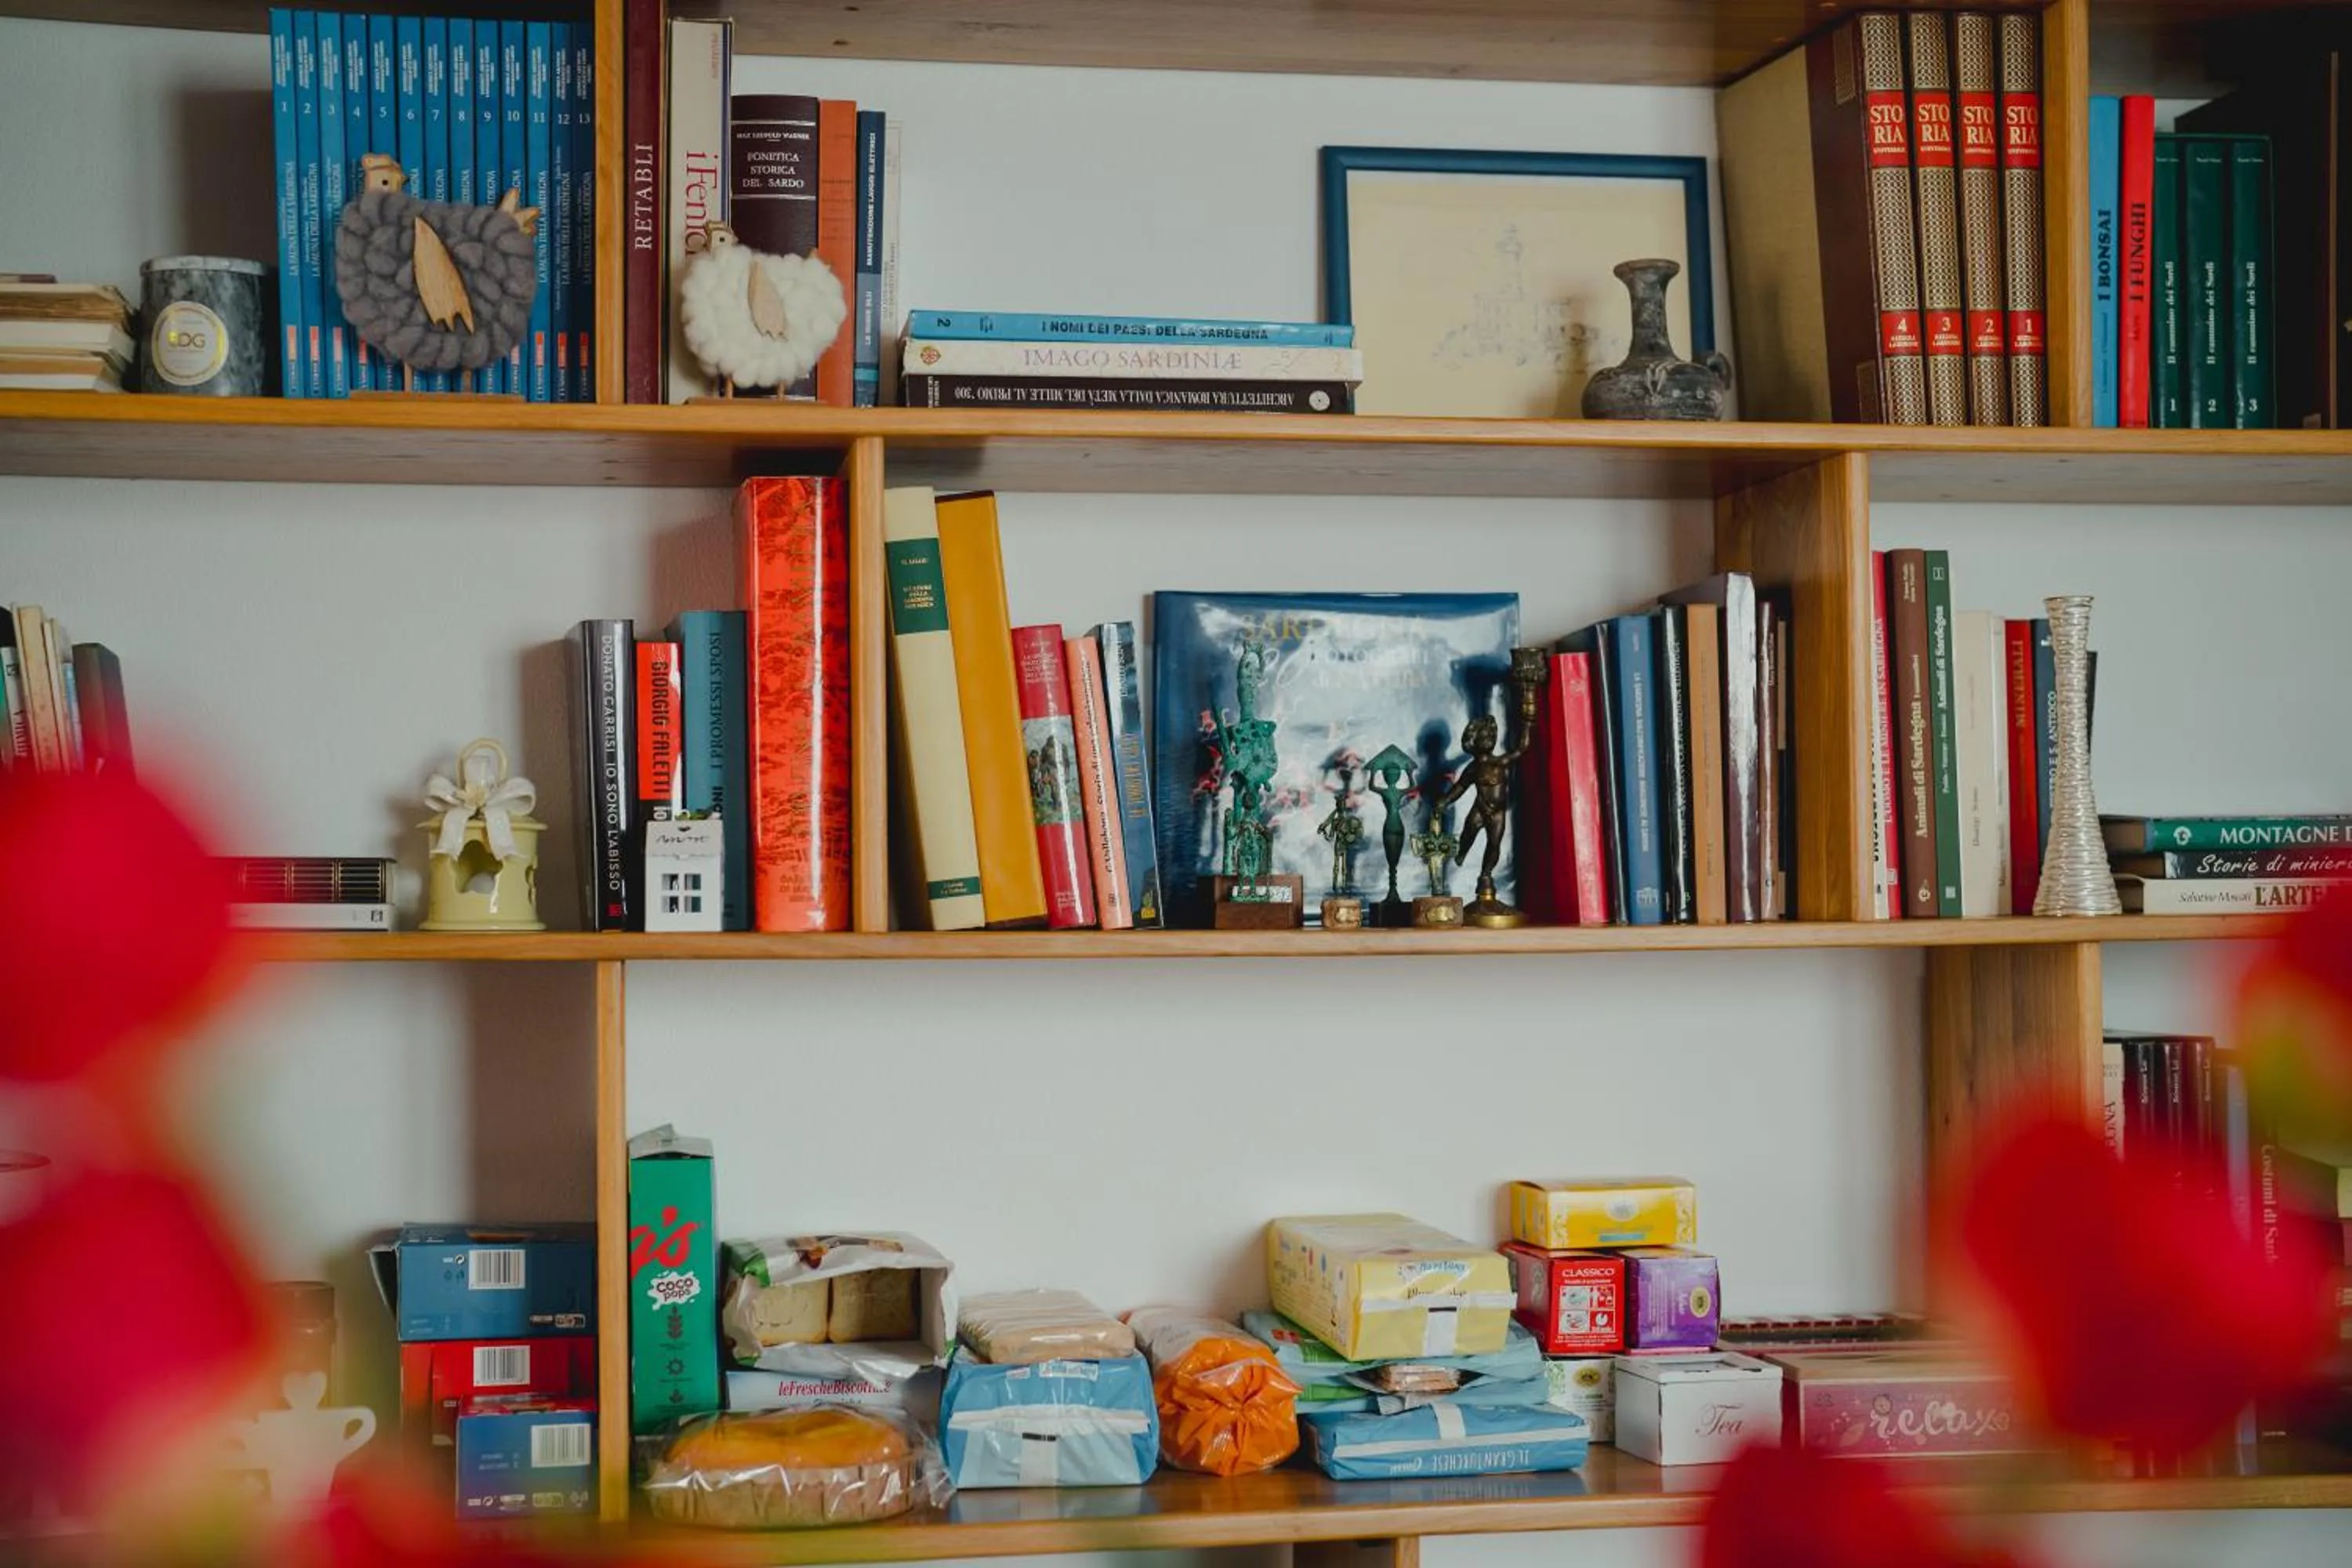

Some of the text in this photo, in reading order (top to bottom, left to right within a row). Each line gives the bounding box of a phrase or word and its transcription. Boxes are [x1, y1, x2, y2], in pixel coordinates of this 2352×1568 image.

[281, 102, 287, 111] 1
[304, 103, 311, 114] 2
[328, 104, 335, 114] 3
[353, 107, 361, 118] 4
[379, 107, 387, 118] 5
[1870, 105, 1903, 123] STO
[1918, 103, 1950, 122] STO
[407, 109, 415, 120] 6
[432, 110, 440, 121] 7
[458, 111, 465, 121] 8
[484, 111, 492, 122] 9
[507, 111, 520, 122] 10
[534, 112, 545, 122] 11
[557, 114, 569, 125] 12
[579, 114, 590, 124] 13
[1964, 106, 1994, 124] STO
[2006, 106, 2038, 125] STO
[1874, 125, 1904, 143] RIA
[1922, 124, 1950, 142] RIA
[1966, 125, 1994, 144] RIA
[2009, 126, 2038, 144] RIA
[747, 152, 800, 162] FONETICA
[750, 165, 796, 175] STORICA
[742, 178, 804, 188] DEL SARDO
[634, 143, 653, 249] RETABLI
[285, 162, 299, 275] LA FAUNA DELLA SARDEGNA
[308, 162, 320, 277] LA FAUNA DELLA SARDEGNA
[561, 219, 570, 245] DELLA
[2097, 209, 2111, 287] BONSAI
[2130, 202, 2145, 286] FUNGHI
[561, 246, 570, 272] FAUNA
[539, 273, 547, 282] LA
[561, 274, 571, 285] LA
[2165, 262, 2174, 288] Sardi
[2205, 262, 2214, 288] Sardi
[2246, 262, 2255, 288] Sardi
[2165, 290, 2174, 305] dei
[2205, 290, 2214, 305] dei
[2246, 290, 2256, 305] dei
[936, 318, 951, 327] 2
[1042, 321, 1268, 339] I NOMI DEI PAESI DELLA SARDEGNA
[1897, 318, 1907, 332] 4
[1942, 317, 1951, 331] 3
[1985, 318, 1994, 332] 2
[2026, 318, 2032, 332] 1
[1023, 350, 1243, 368] IMAGO SARDINIÆ
[978, 388, 1011, 401] PRIMO
[1013, 388, 1027, 401] AL
[1029, 388, 1063, 401] MILLE
[1065, 389, 1085, 401] DEL
[1120, 390, 1153, 403] DALLA
[1156, 390, 1210, 405] ROMANICA
[1213, 391, 1294, 405] ARCHITETTURA
[2170, 398, 2176, 412] 1
[2208, 398, 2216, 412] 2
[2249, 398, 2257, 412] 3
[709, 633, 722, 676] SPOSI
[1934, 605, 1947, 710] Animali di Sardegna
[2012, 641, 2026, 728] MINERALI
[652, 662, 670, 725] GIORGIO
[710, 681, 723, 758] PROMESSI
[2048, 691, 2056, 742] ANTIOCO
[1910, 702, 1927, 768] Sardegna
[602, 635, 620, 891] DONATO CARRISI IO SONO L'ABISSO
[652, 731, 670, 793] FALETTI
[1913, 771, 1925, 784] di
[1915, 786, 1928, 837] Animali
[2220, 826, 2339, 844] MONTAGNE
[2197, 854, 2258, 873] Storie
[2267, 854, 2286, 872] di
[2254, 885, 2324, 906] L'ARTE
[2261, 1145, 2279, 1264] Costumi di Sard
[1562, 1268, 1614, 1278] CLASSICO
[664, 1288, 691, 1302] pops
[1695, 1402, 1744, 1437] Tea
[1870, 1401, 1997, 1439] relax
[1519, 1449, 1530, 1465] IL
